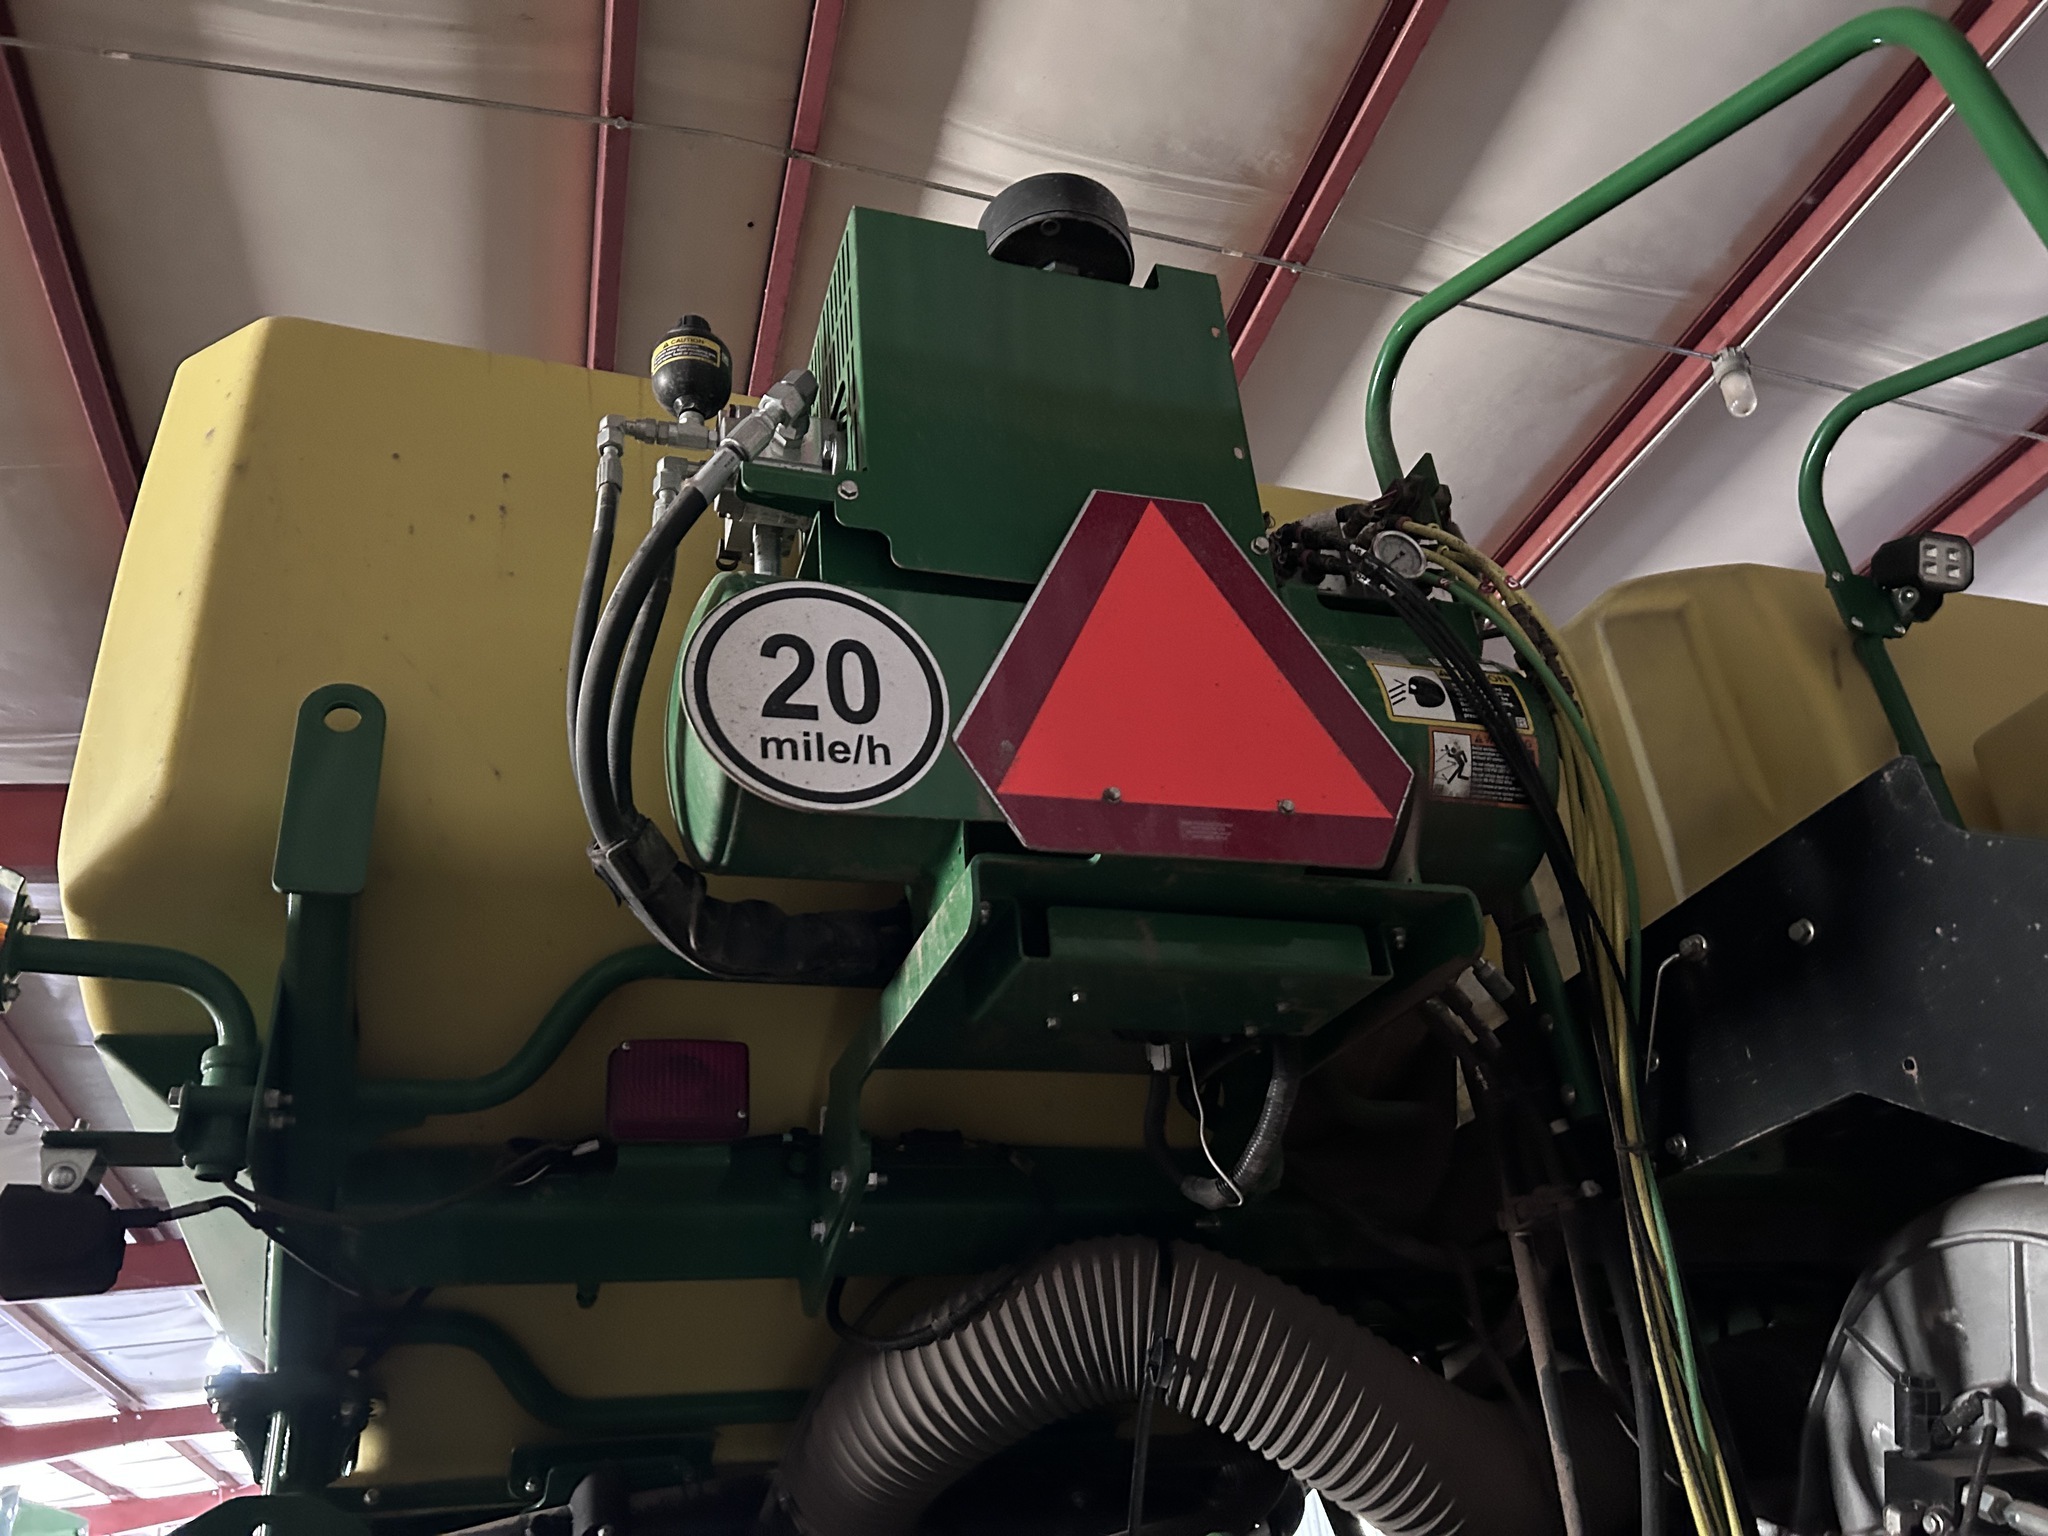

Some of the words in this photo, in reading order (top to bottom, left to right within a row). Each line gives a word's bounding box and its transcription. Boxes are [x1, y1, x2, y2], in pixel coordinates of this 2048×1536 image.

[671, 337, 705, 345] CAUTION
[760, 633, 881, 725] 20
[760, 731, 892, 766] mile/h
